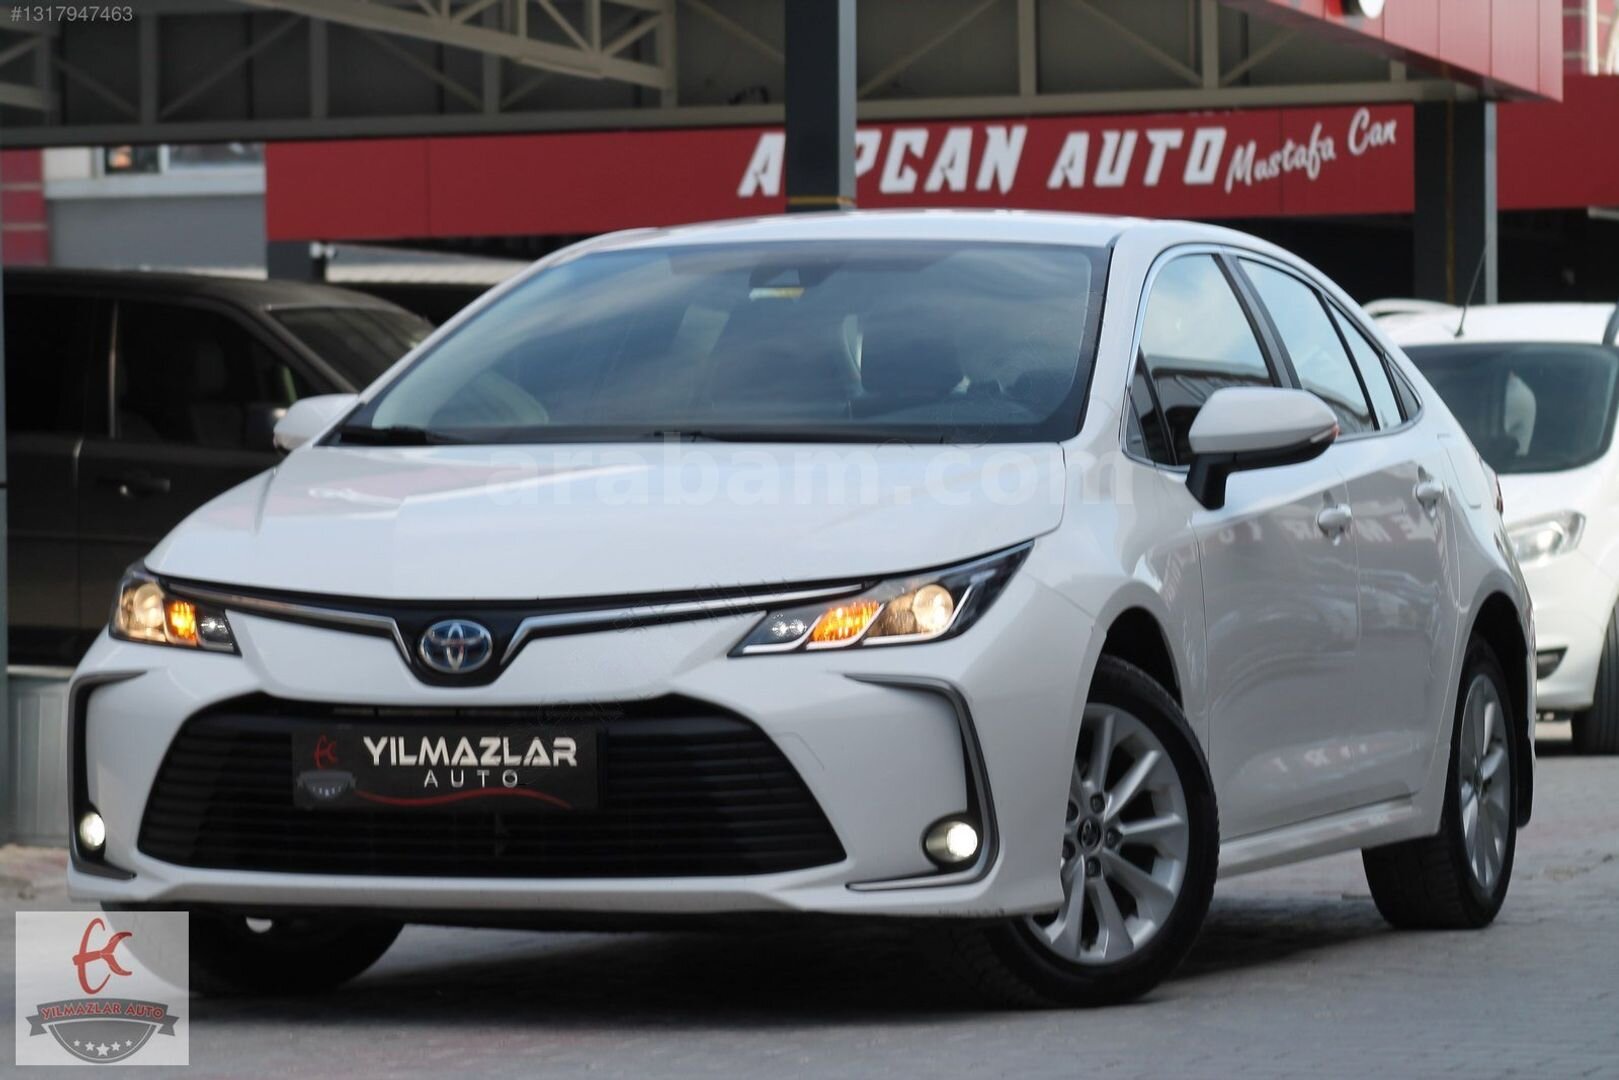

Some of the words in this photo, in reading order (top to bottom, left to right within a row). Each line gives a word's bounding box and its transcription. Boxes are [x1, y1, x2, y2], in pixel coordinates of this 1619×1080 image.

[737, 126, 1028, 197] APCAN
[1047, 127, 1226, 189] AUTO
[1225, 121, 1335, 194] Mustafa
[1347, 107, 1397, 156] Can
[363, 735, 577, 767] YILMAZLAR
[424, 769, 519, 789] AUTO
